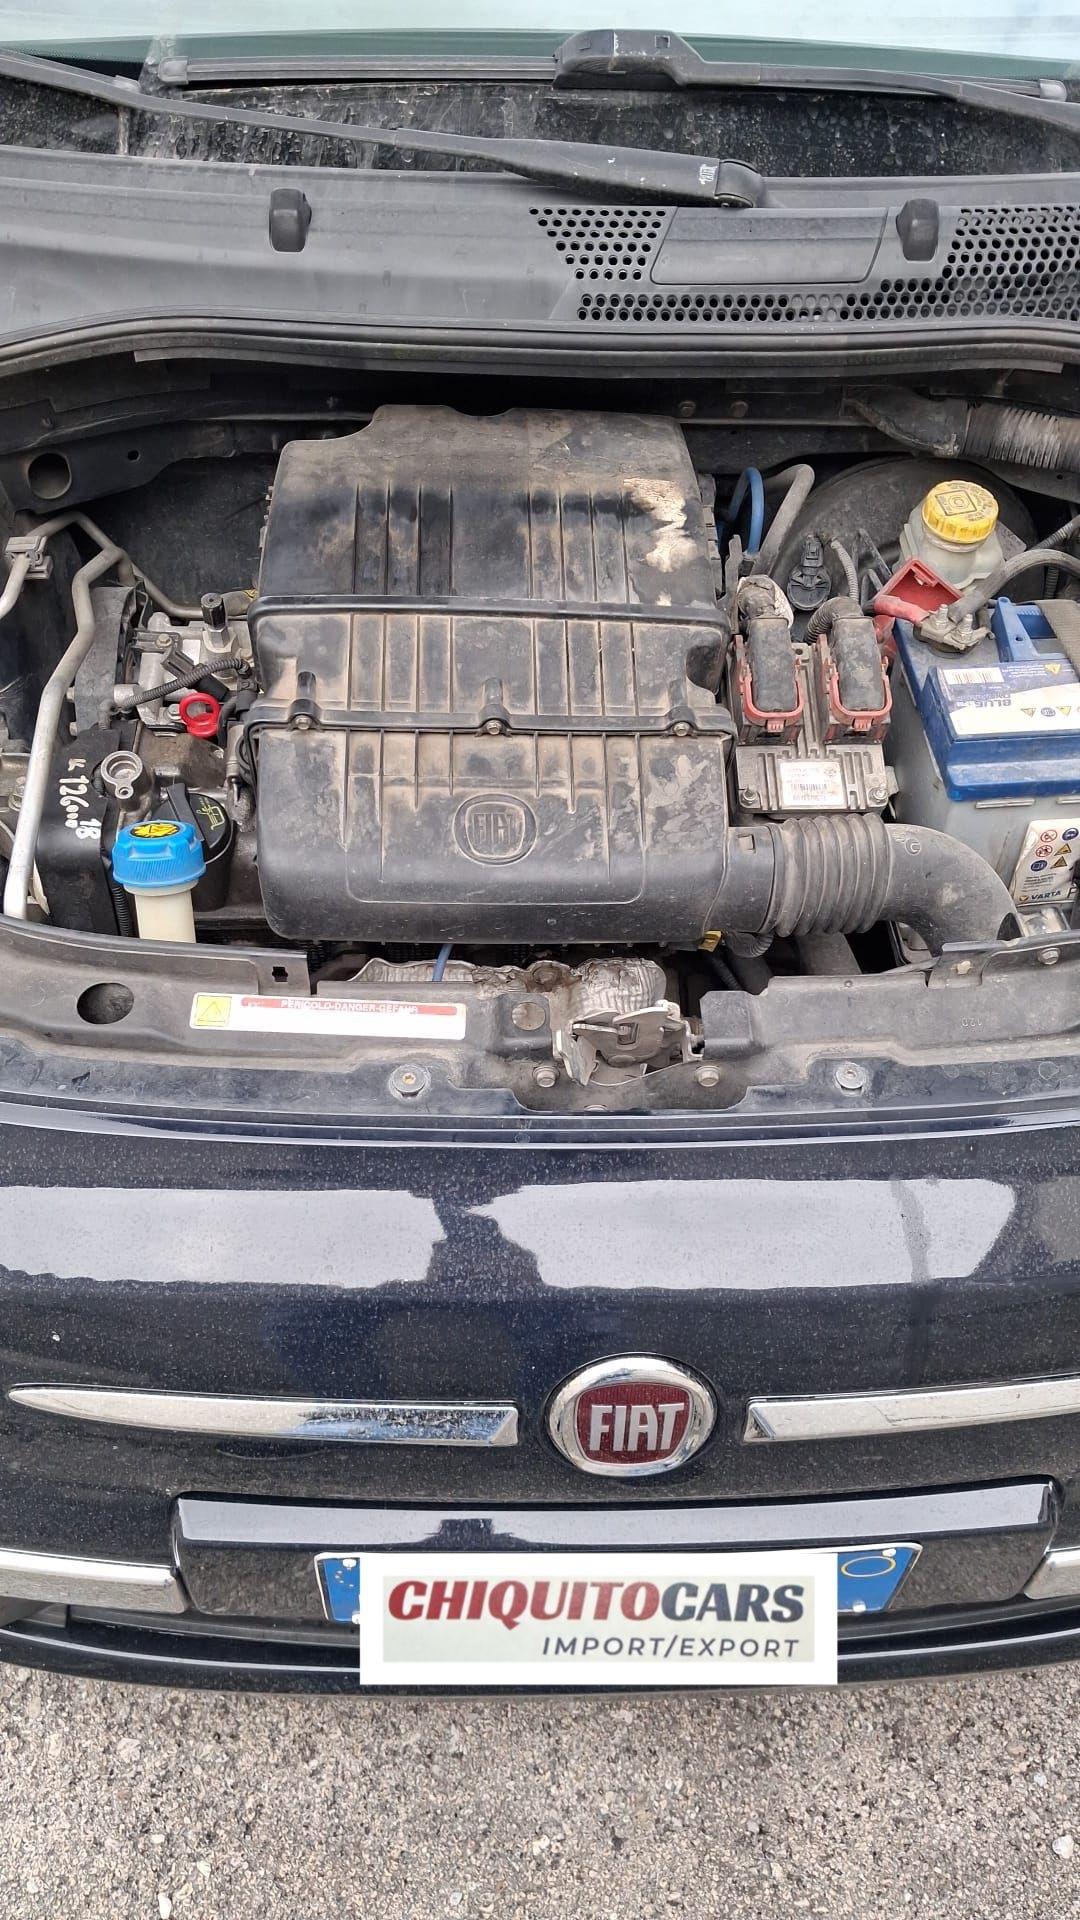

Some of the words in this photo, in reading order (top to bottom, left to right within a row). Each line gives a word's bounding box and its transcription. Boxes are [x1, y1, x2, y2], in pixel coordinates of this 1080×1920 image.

[75, 818, 102, 840] 18
[1030, 890, 1062, 900] VARTA
[589, 1402, 685, 1452] FIAT
